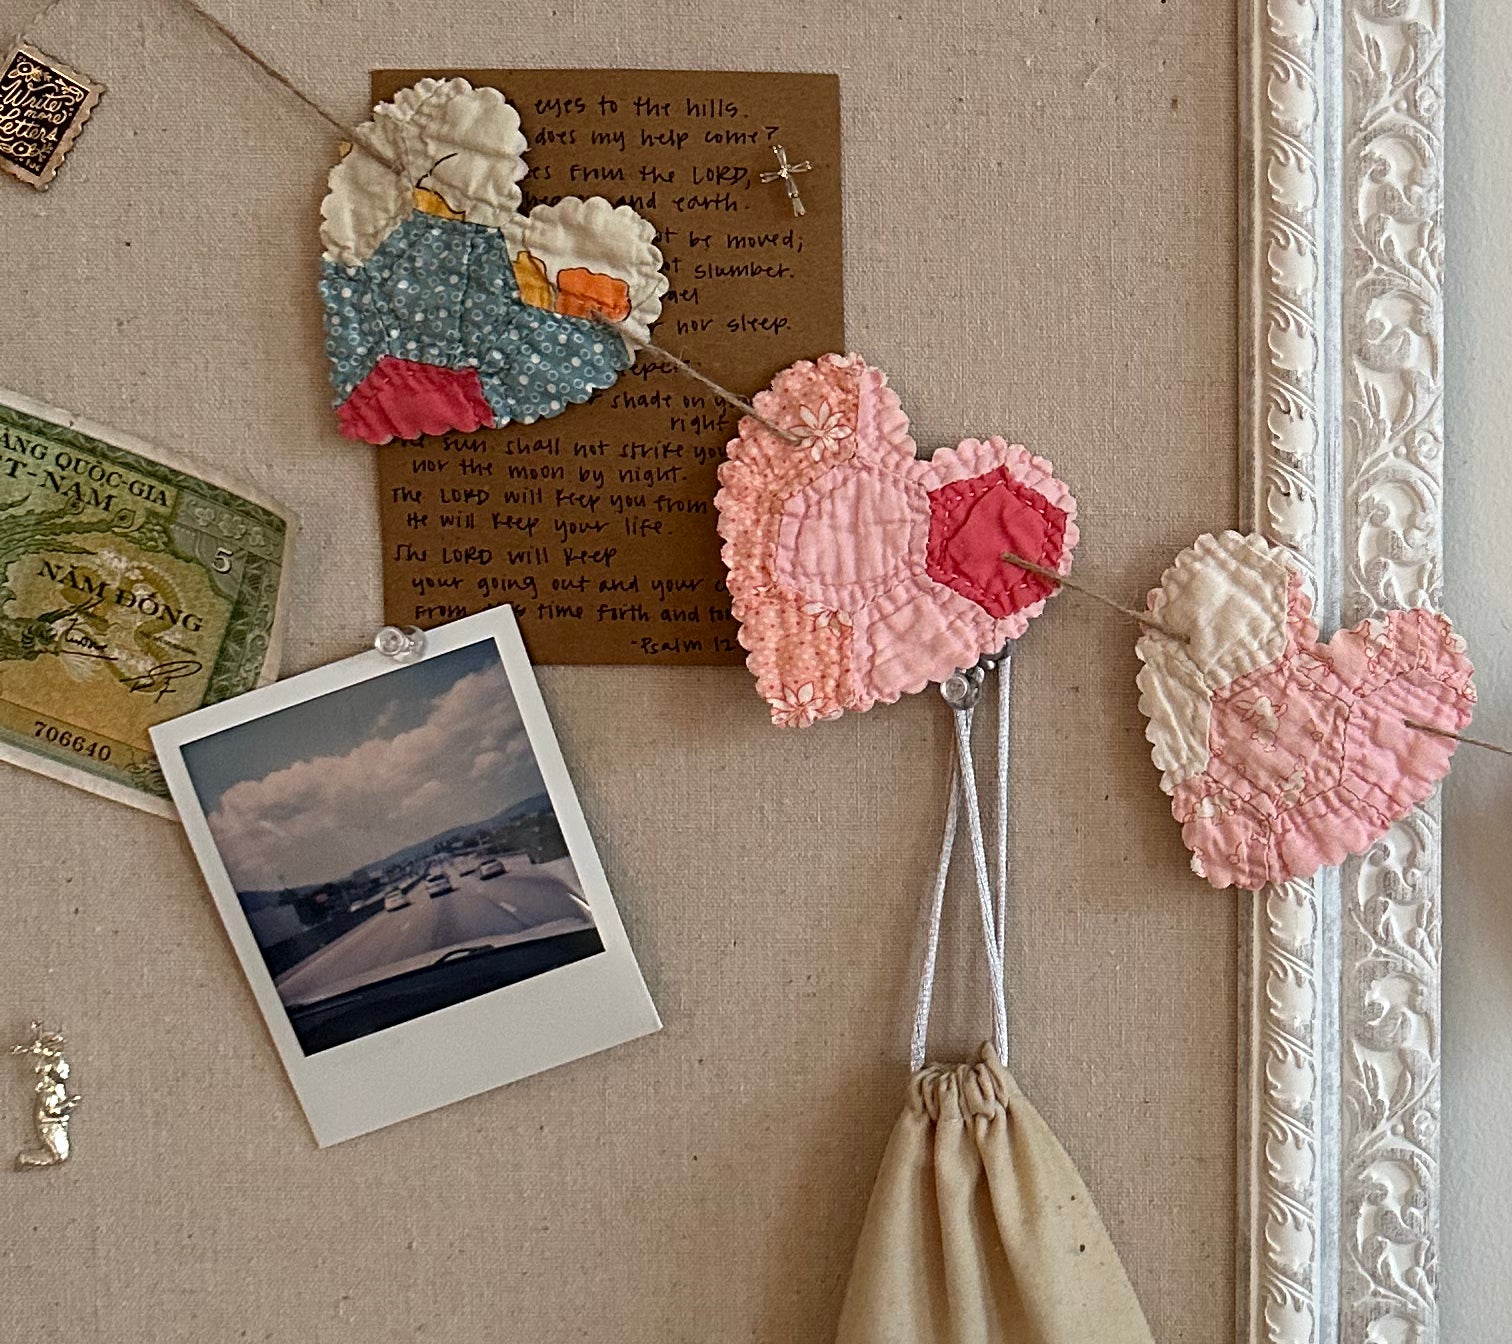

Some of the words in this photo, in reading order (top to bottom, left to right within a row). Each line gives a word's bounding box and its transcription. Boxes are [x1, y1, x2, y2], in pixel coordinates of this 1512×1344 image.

[1, 80, 75, 112] Write
[535, 97, 586, 117] eyes
[599, 95, 618, 116] to
[633, 96, 672, 117] the
[686, 98, 749, 118] hills.
[24, 109, 68, 124] more
[535, 128, 576, 144] does
[592, 129, 625, 151] my
[641, 128, 689, 149] help
[705, 126, 779, 144] come?
[639, 165, 675, 183] the
[693, 166, 751, 189] LORD,
[616, 192, 656, 209] and
[673, 192, 750, 210] earth.
[689, 231, 712, 249] be
[727, 230, 804, 252] moved;
[694, 262, 794, 279] slumber.
[677, 319, 713, 336] nor
[727, 315, 791, 333] sleep.
[611, 390, 672, 409] shade
[683, 395, 705, 408] on
[670, 407, 729, 435] right
[442, 436, 487, 453] sun
[505, 437, 560, 455] shall
[574, 440, 610, 457] not
[619, 441, 684, 459] strike
[413, 459, 449, 473] nor
[459, 458, 493, 476] the
[509, 465, 564, 479] moon
[579, 466, 604, 489] by
[619, 466, 687, 487] night.
[392, 486, 422, 504] The
[440, 488, 490, 505] LORD
[504, 487, 542, 504] will
[610, 494, 646, 514] you
[406, 511, 428, 530] He
[440, 510, 474, 529] will
[554, 518, 610, 543] your
[625, 516, 673, 537] life.
[211, 546, 234, 574] 5
[443, 546, 493, 565] LORD
[507, 545, 549, 565] will
[412, 576, 464, 596] your
[477, 574, 538, 599] going
[552, 575, 591, 592] out
[599, 575, 639, 592] and
[651, 578, 704, 601] your
[537, 601, 584, 620] time
[597, 603, 649, 622] forth
[661, 606, 700, 622] and
[34, 720, 112, 762] 706640
